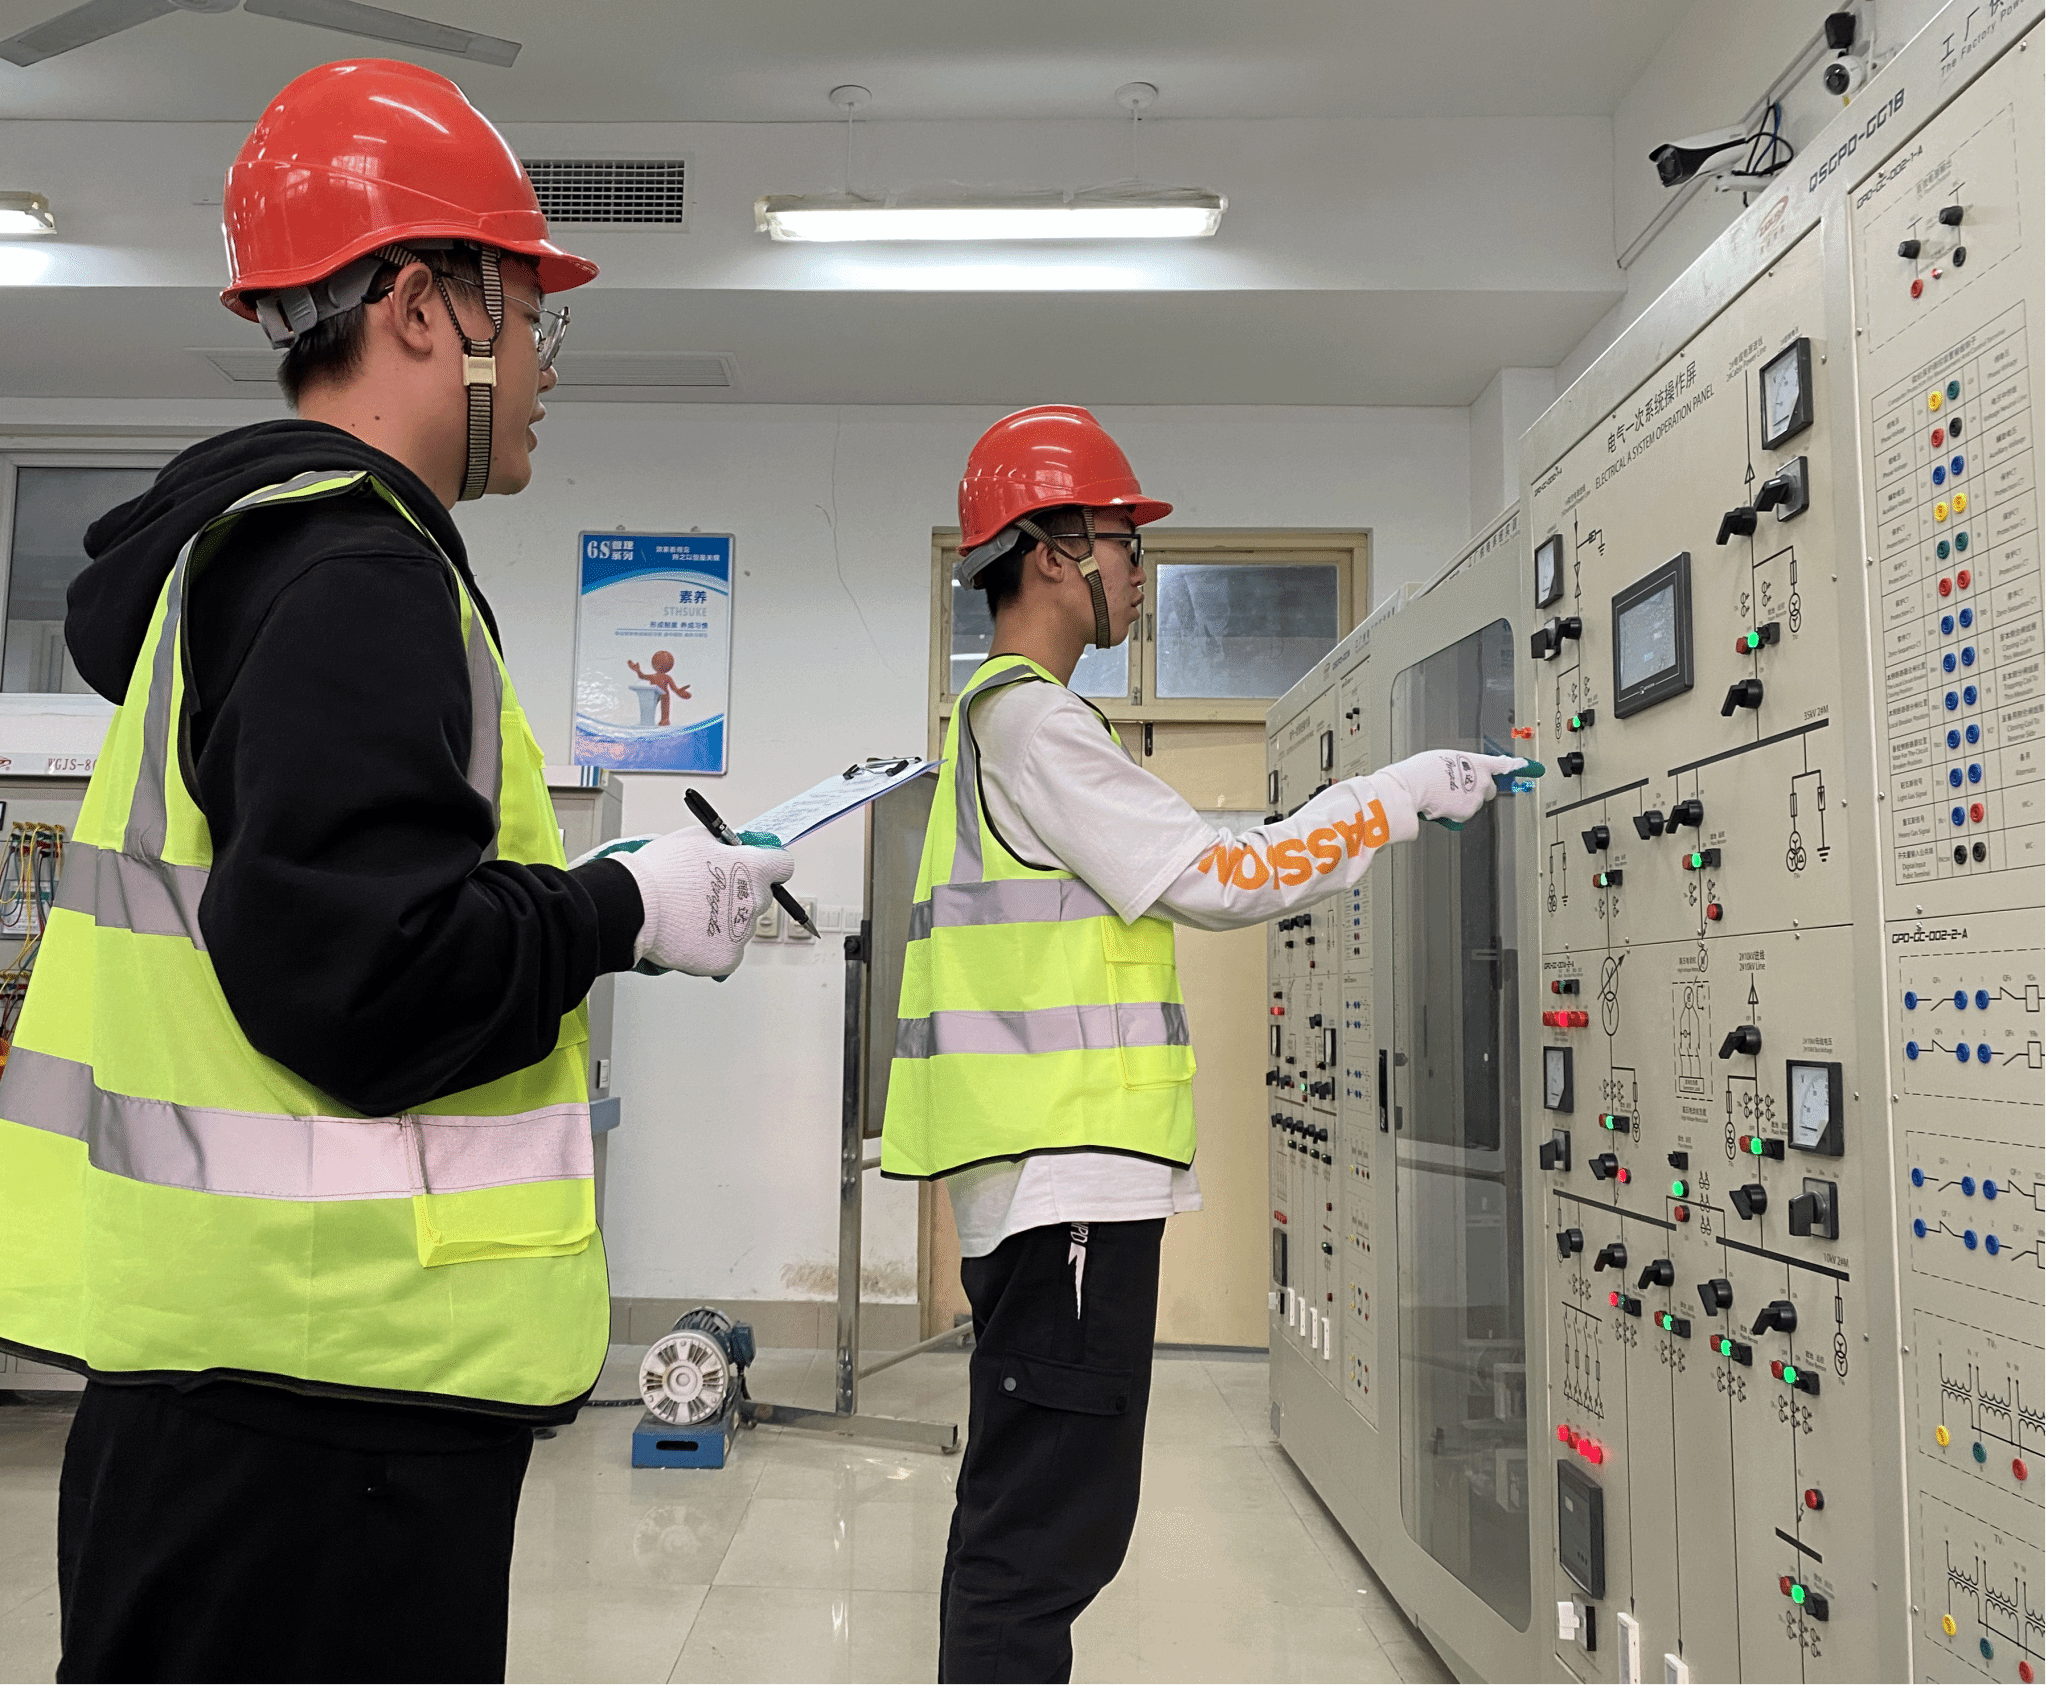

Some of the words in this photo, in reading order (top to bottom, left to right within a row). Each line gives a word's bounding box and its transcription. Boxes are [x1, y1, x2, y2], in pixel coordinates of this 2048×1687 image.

[1961, 21, 1997, 59] Factory
[1596, 456, 1627, 489] ELECTRICAL
[1627, 451, 1632, 465] A
[1632, 431, 1655, 460] SYSTEM
[1656, 401, 1691, 440] OPERATION
[1693, 383, 1714, 411] PANEL
[1608, 360, 1696, 453] 电气一次系统操作屏
[587, 540, 610, 559] 6S
[679, 590, 707, 604] 素养
[1197, 798, 1390, 891] PASSION
